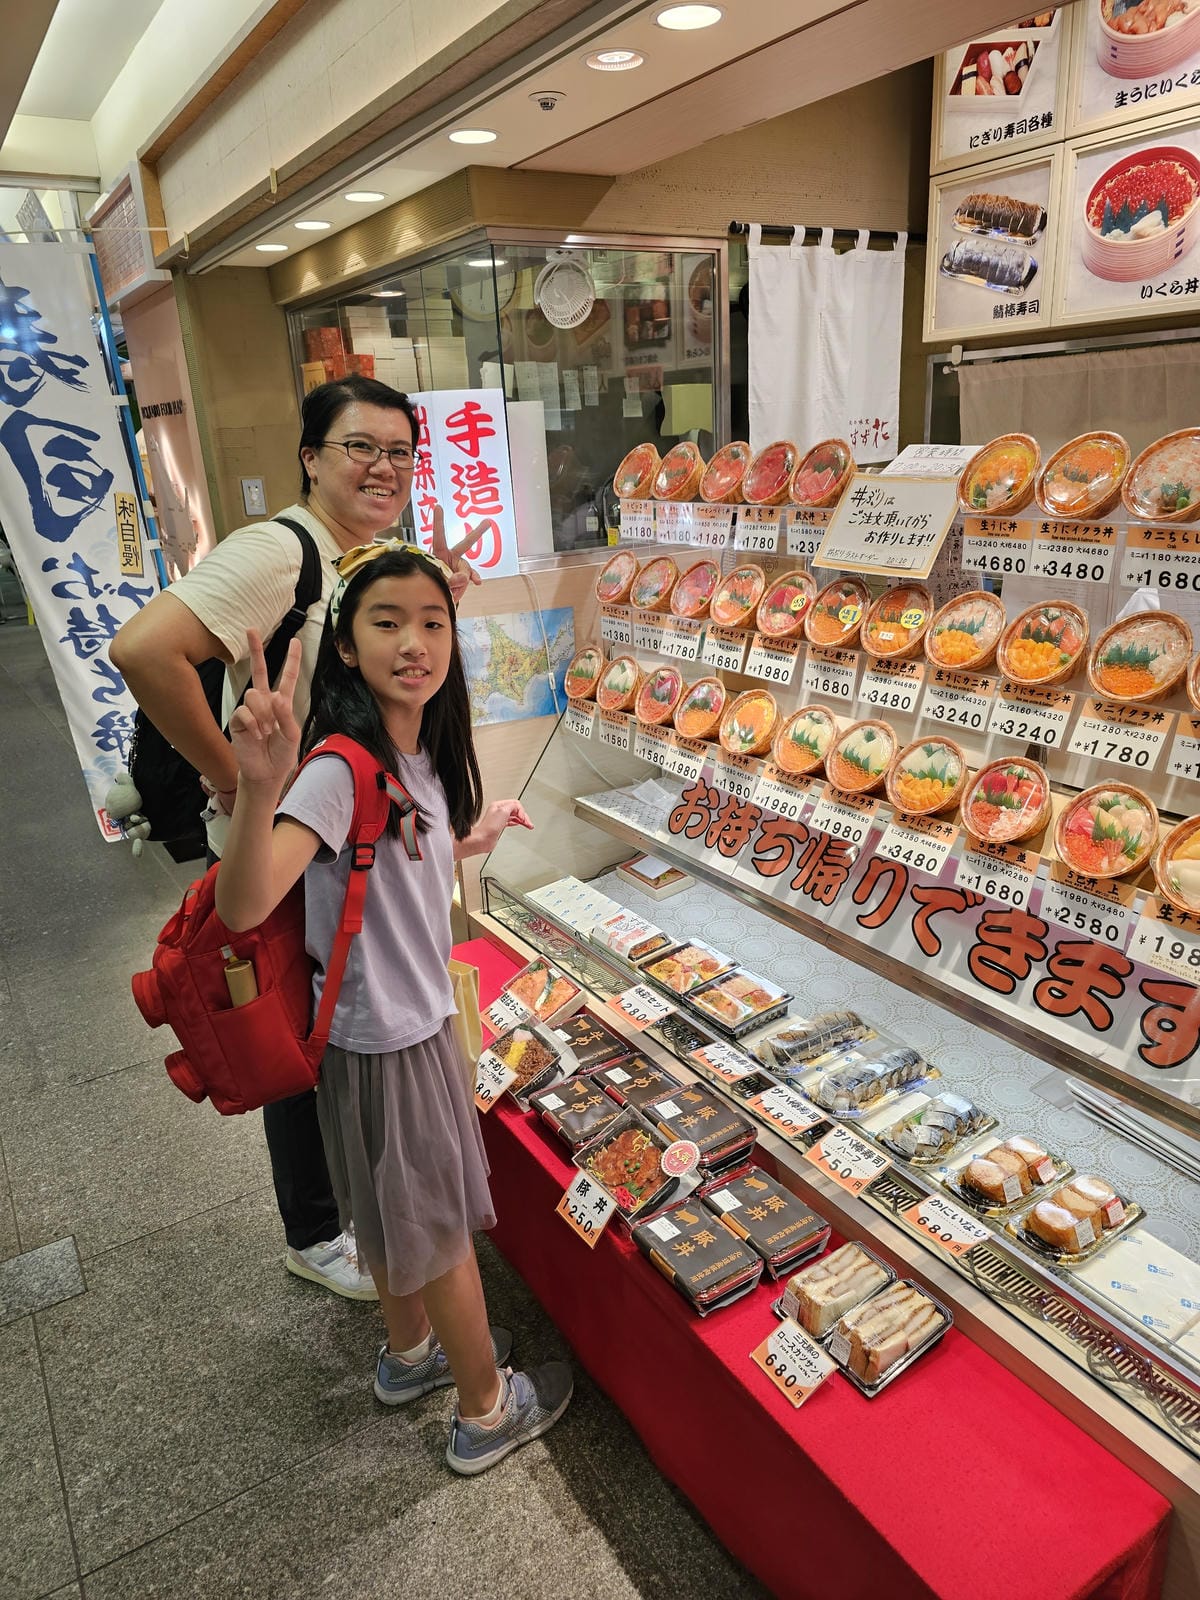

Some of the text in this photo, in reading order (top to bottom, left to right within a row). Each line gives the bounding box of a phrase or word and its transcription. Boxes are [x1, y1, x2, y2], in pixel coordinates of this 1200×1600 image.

[969, 111, 1054, 149] にぎり寿司各種
[1140, 277, 1200, 301] いくら丼
[992, 299, 1040, 320] 鯖棒寿司
[445, 401, 504, 568] 手造り
[850, 484, 896, 508] 丼ぶりは
[848, 509, 932, 529] ご注文頂いてから
[979, 519, 1018, 533] 生うに丼
[1040, 521, 1114, 539] 生うにイクラ丼
[935, 670, 990, 690] 生うにカニ丼
[1002, 683, 1072, 705] 生うにサーモン丼
[1094, 702, 1165, 725] カニイクラ丼
[829, 788, 875, 810] イカイクラ丼
[898, 813, 953, 838] 生うにイカ丼
[1015, 851, 1028, 864] 並
[1107, 883, 1120, 896] 上
[1156, 903, 1200, 931] 生チ
[487, 1056, 506, 1077] 牛めし
[475, 1083, 493, 1105] 80円
[623, 1071, 663, 1094] 牛めし
[559, 1094, 604, 1120] 牛めし
[679, 1105, 718, 1129] 豚丼
[833, 1129, 887, 1168] サバ棒寿司
[837, 1145, 862, 1162] ハーフ
[818, 1150, 863, 1190] 750円
[575, 1178, 608, 1214] 豚丼
[745, 1195, 788, 1222] 豚丼
[928, 1198, 987, 1238] かにいなり
[671, 1229, 717, 1258] 豚丼
[916, 1215, 962, 1253] 680円
[777, 1330, 826, 1380] ロースカツサンド
[765, 1352, 804, 1400] 680円
